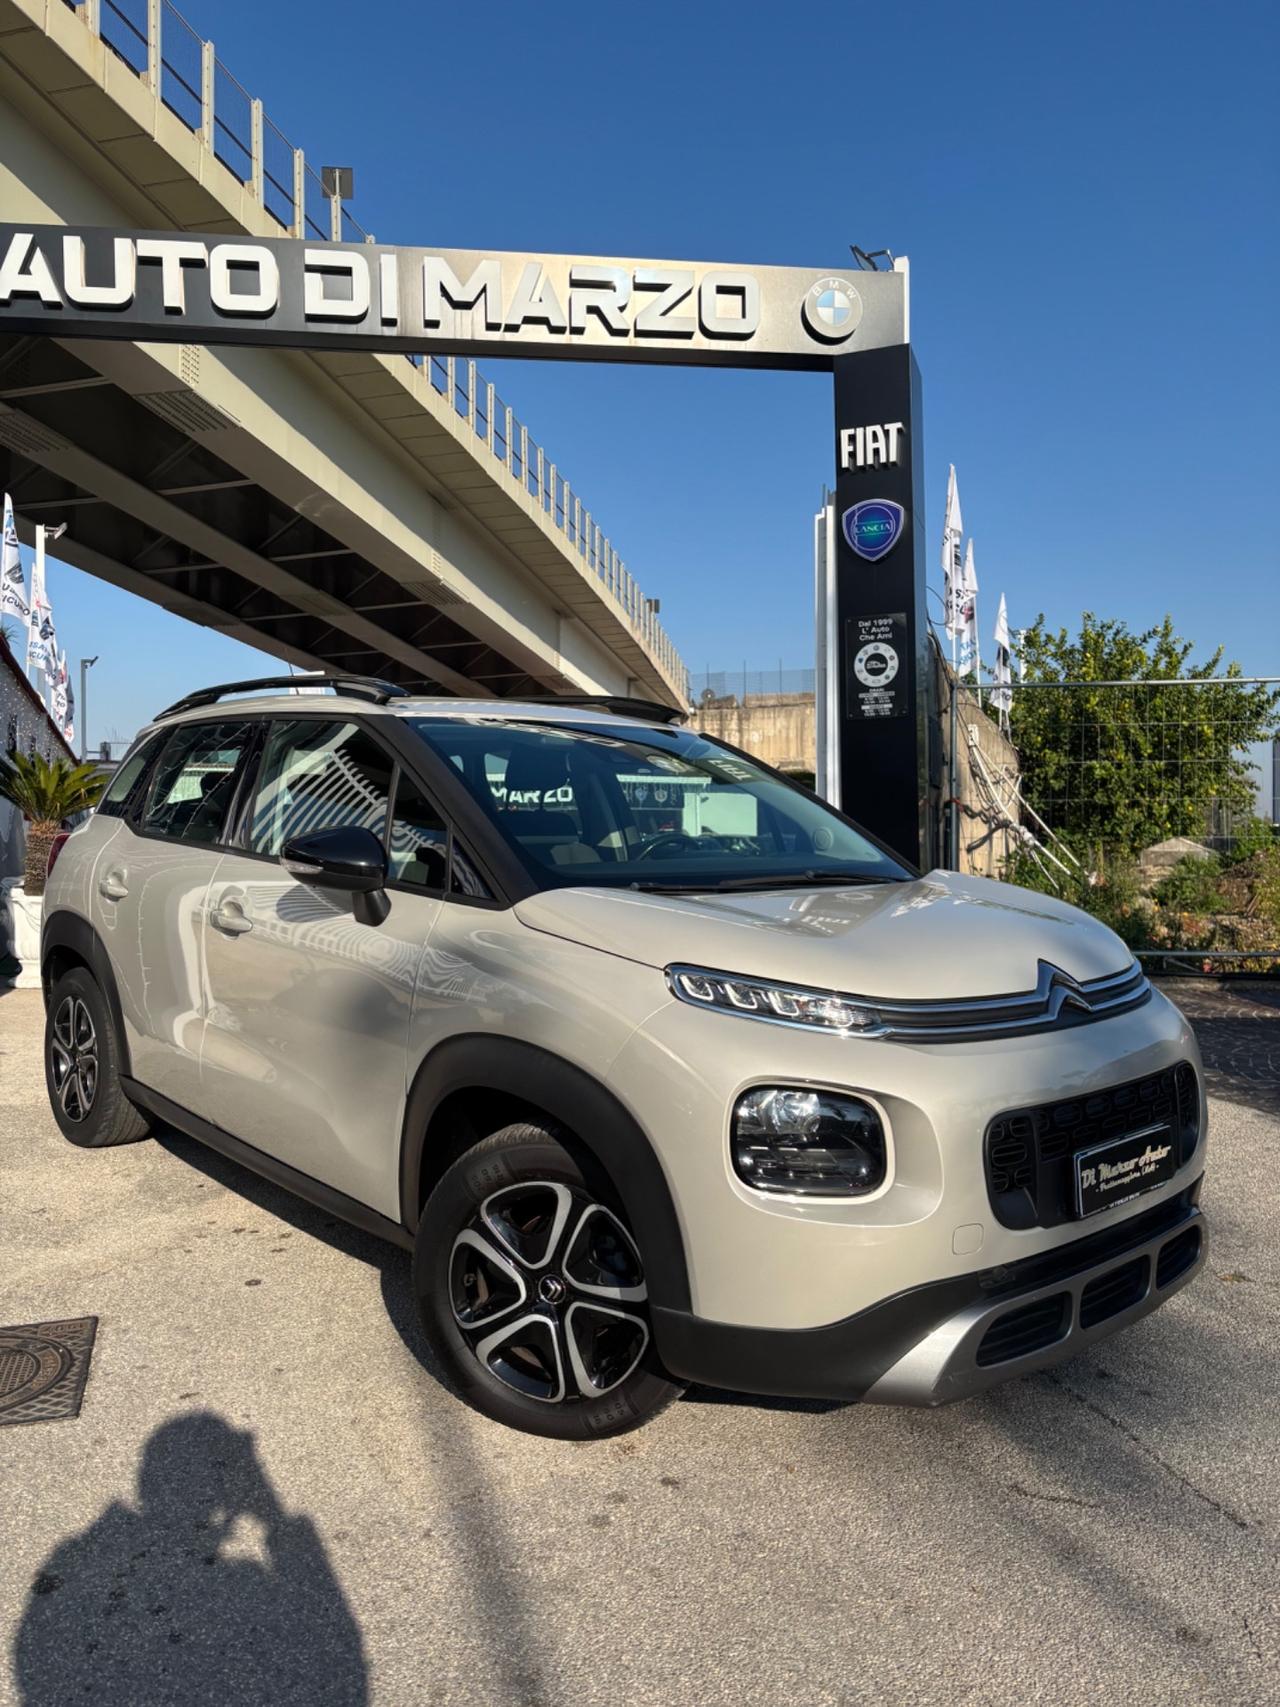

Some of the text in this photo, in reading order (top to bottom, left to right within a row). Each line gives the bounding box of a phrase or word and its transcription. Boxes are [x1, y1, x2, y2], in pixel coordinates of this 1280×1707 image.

[0, 233, 761, 338] AUTO DI MARZO
[811, 280, 857, 299] BMW
[840, 421, 904, 469] FIAT
[855, 522, 891, 535] LANCIA
[858, 620, 871, 628] Dal
[859, 632, 893, 641] Che Ami
